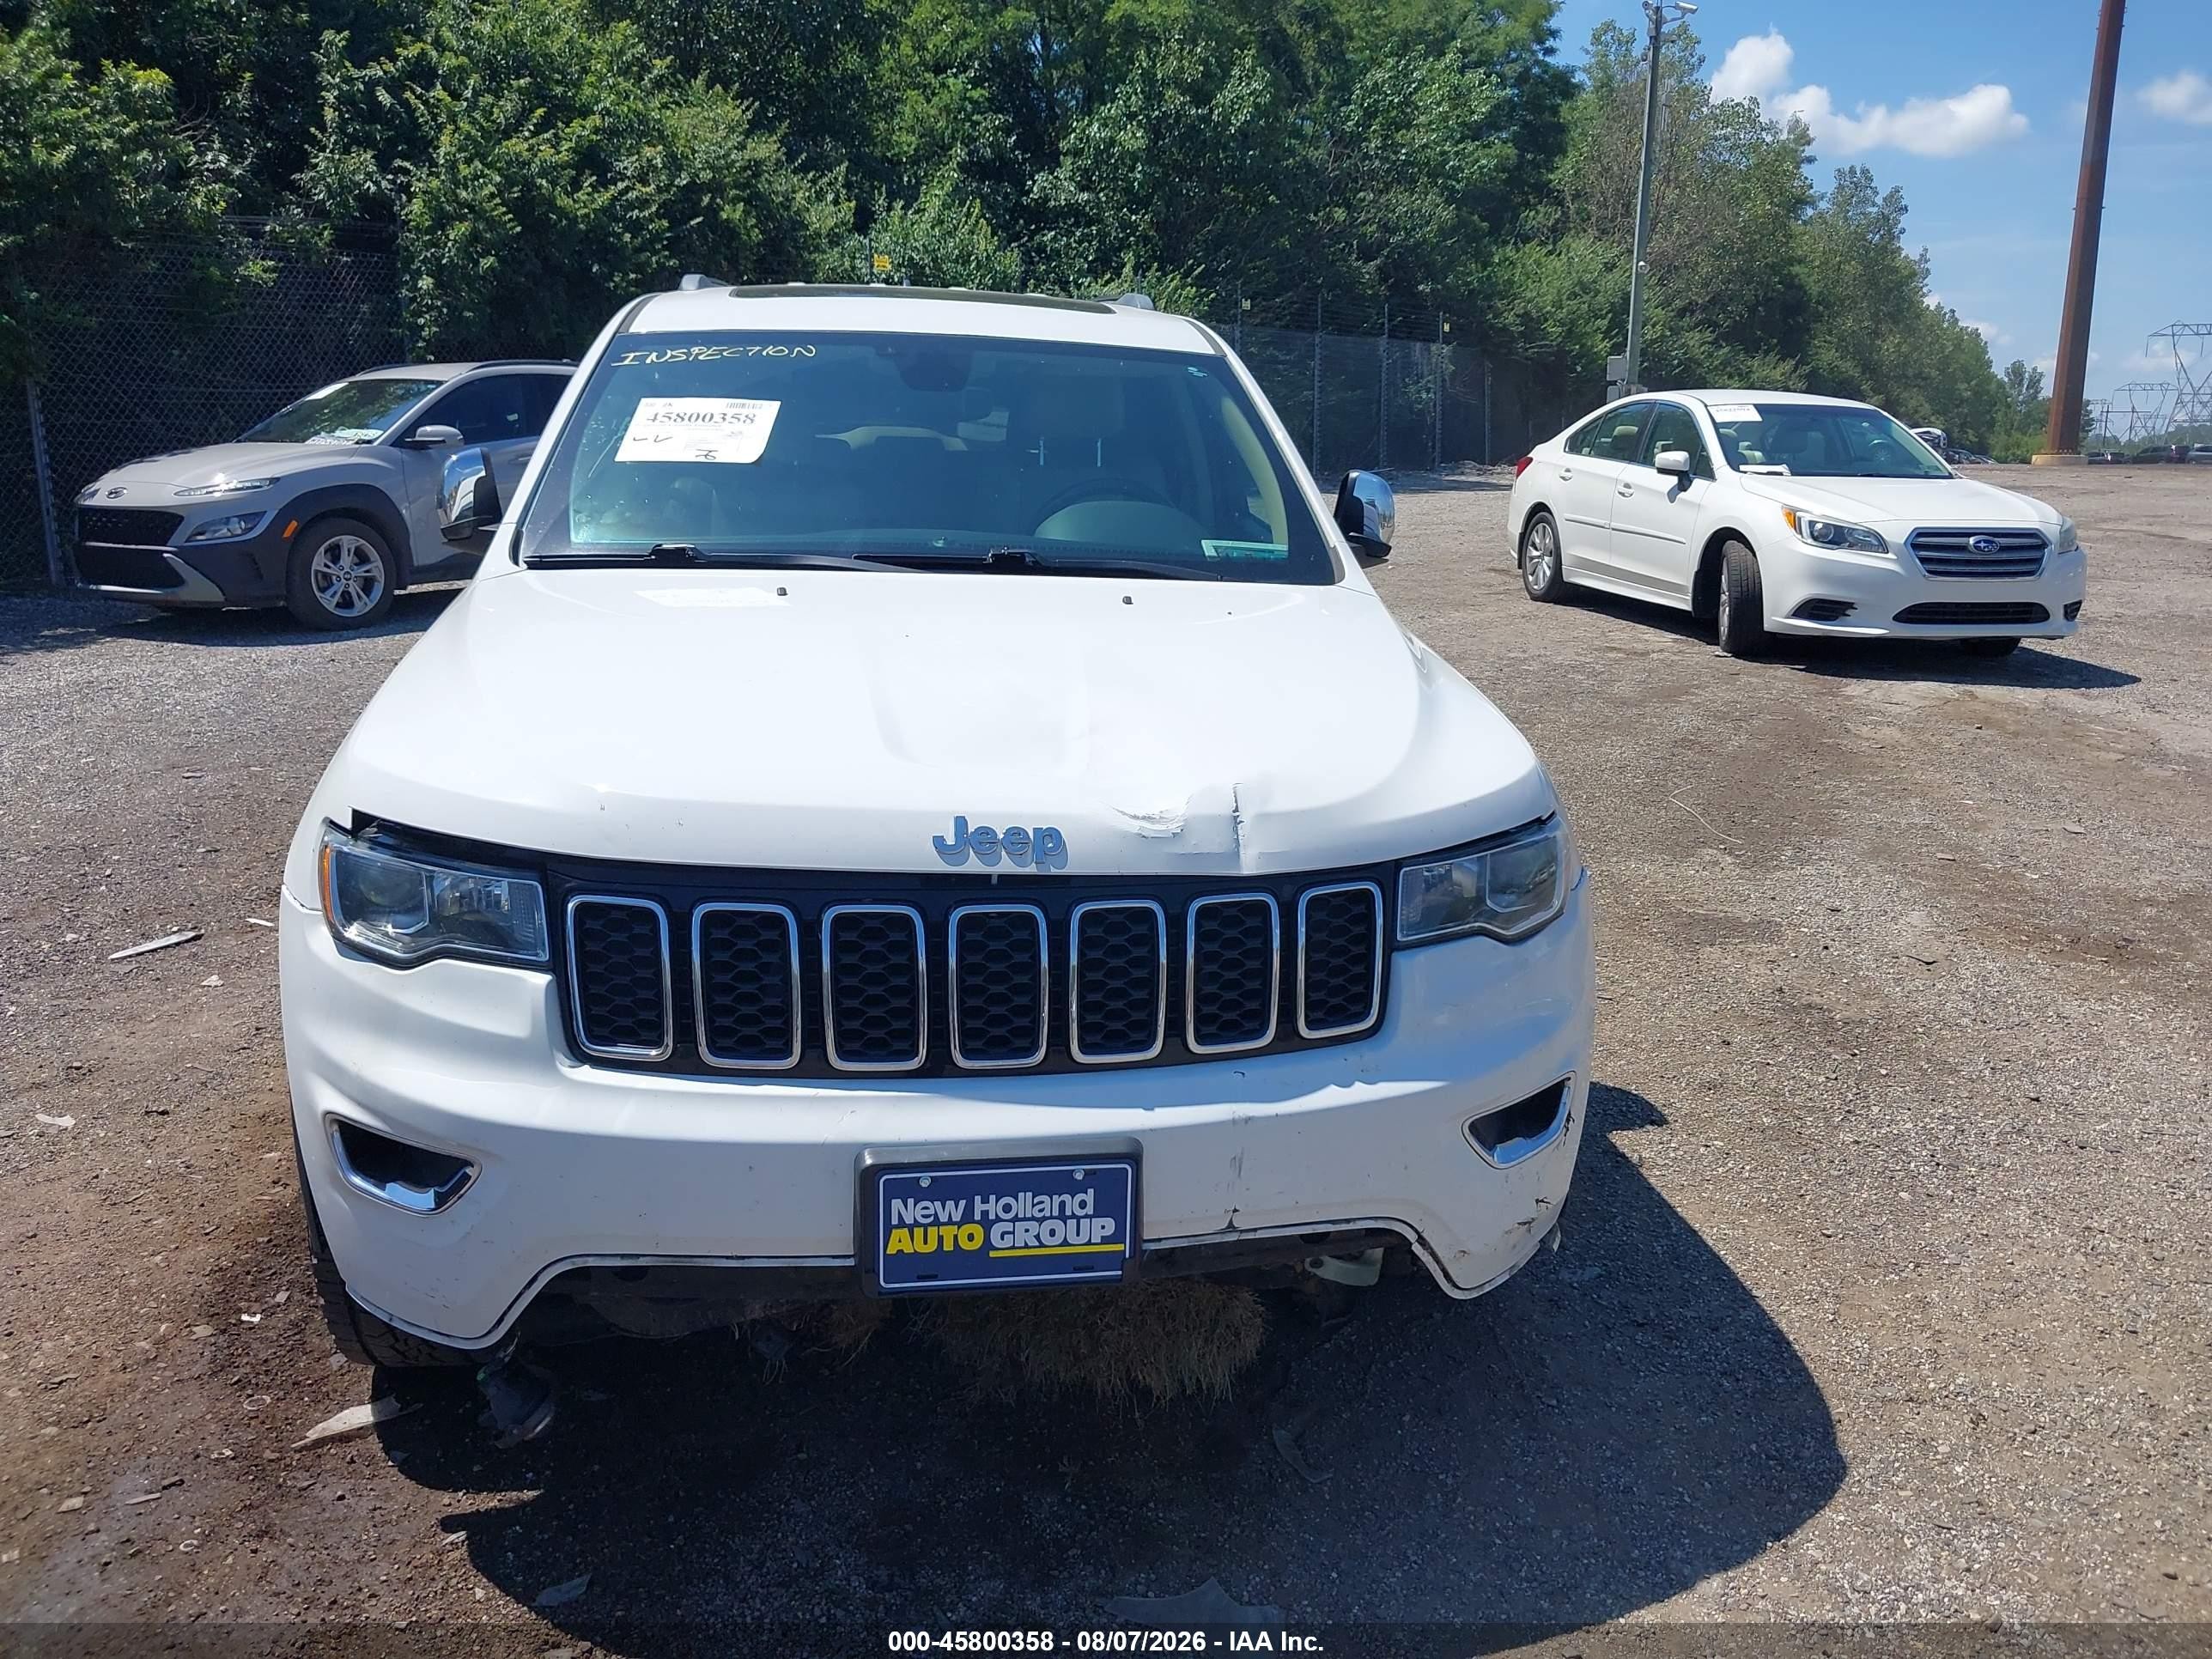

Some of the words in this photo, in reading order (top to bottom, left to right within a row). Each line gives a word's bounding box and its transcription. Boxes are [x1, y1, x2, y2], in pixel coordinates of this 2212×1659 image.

[611, 344, 817, 367] INSPECTION
[647, 411, 757, 424] 45800358
[932, 815, 1066, 865] Jeep
[890, 1197, 966, 1225] New
[974, 1188, 1095, 1221] Holland
[885, 1222, 985, 1255] AUTO
[989, 1217, 1115, 1249] GROUP
